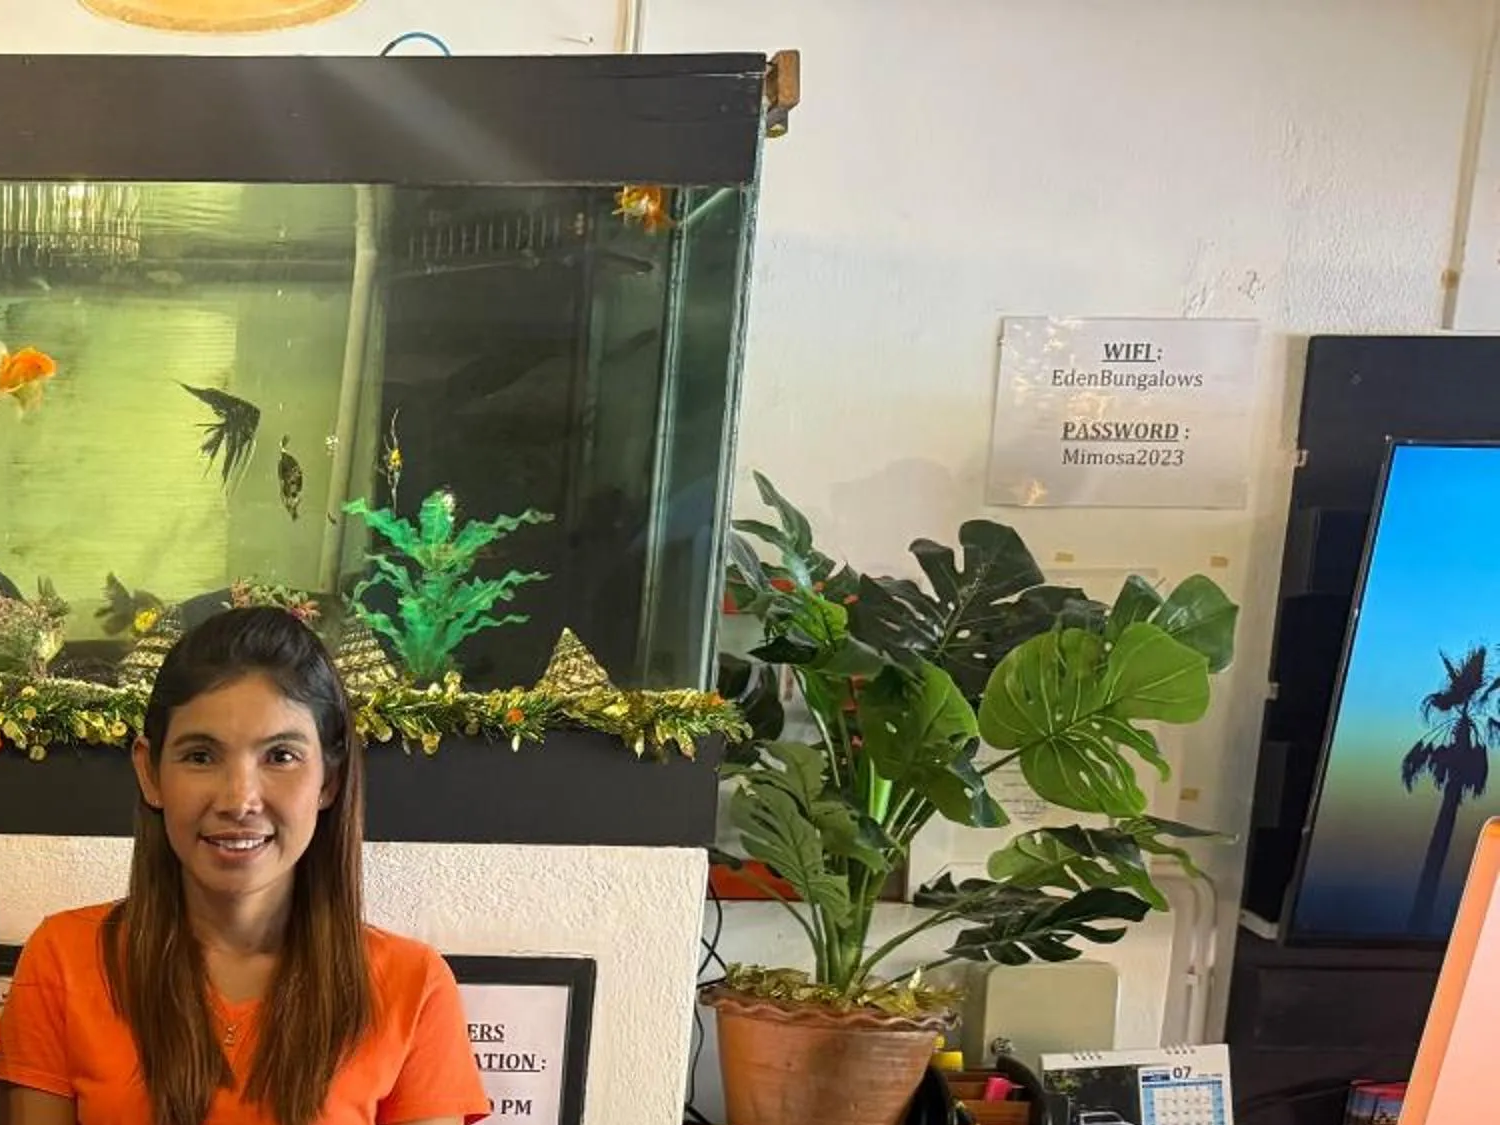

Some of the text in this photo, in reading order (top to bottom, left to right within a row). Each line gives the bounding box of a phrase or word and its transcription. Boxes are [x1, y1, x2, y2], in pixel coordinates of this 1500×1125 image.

[1103, 343, 1152, 360] WIFI
[1051, 369, 1203, 390] EdenBungalows
[1062, 422, 1179, 440] PASSWORD
[1062, 449, 1184, 466] Mimosa2023
[467, 1024, 505, 1040] ERS
[1173, 1066, 1191, 1079] 07
[501, 1099, 532, 1115] PM
